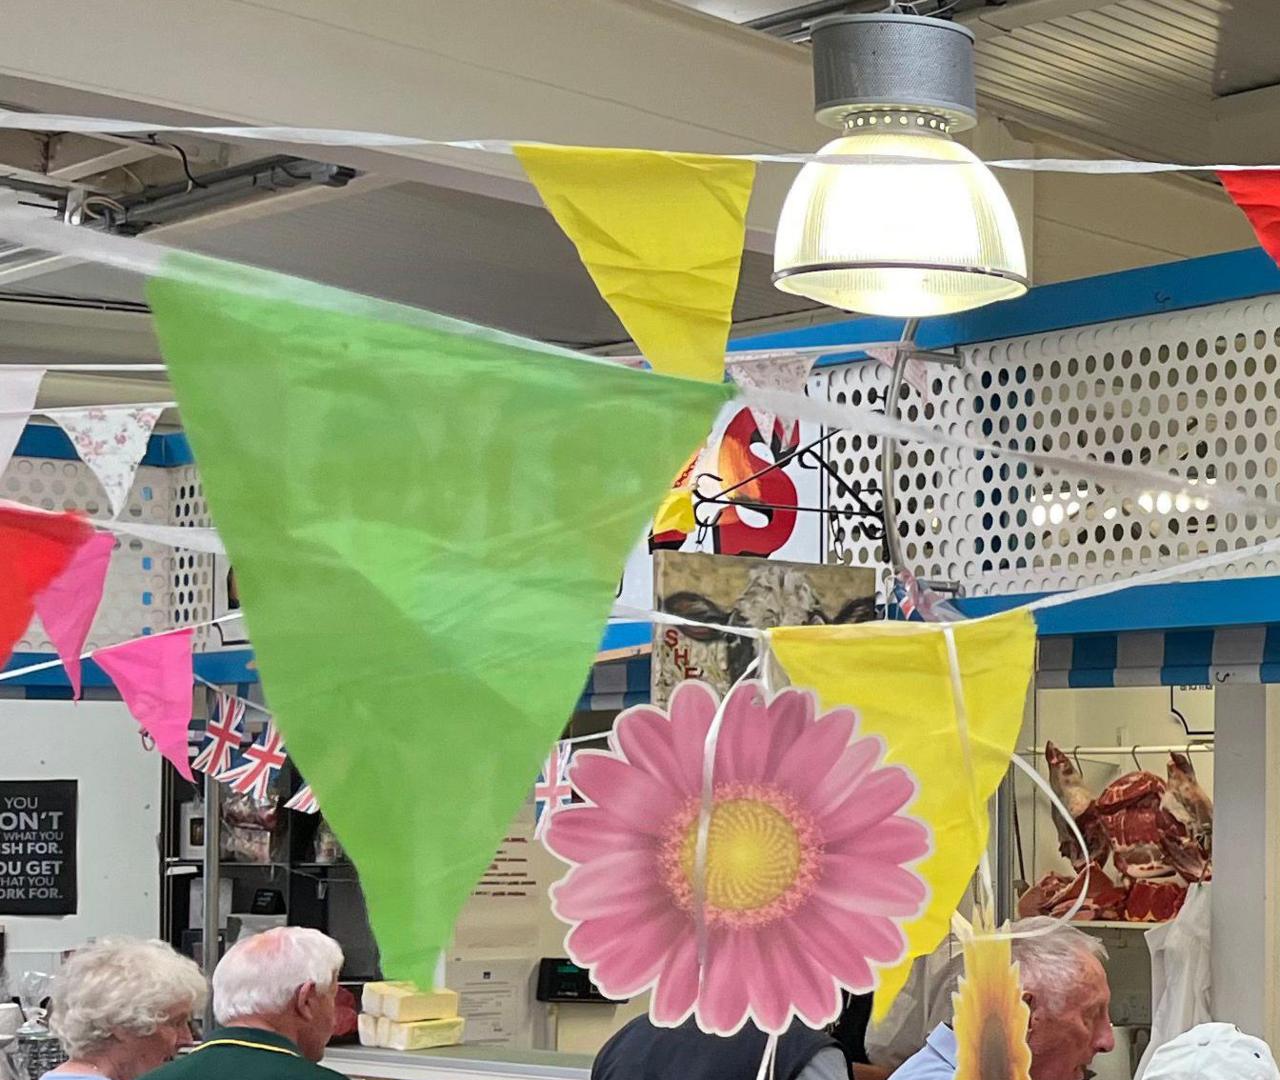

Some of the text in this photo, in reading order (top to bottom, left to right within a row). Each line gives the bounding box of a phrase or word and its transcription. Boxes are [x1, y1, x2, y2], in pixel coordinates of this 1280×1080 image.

[4, 796, 39, 809] YOU
[3, 831, 64, 841] WHAT YOU
[26, 842, 63, 855] FOR.
[25, 860, 64, 875] GET
[27, 876, 55, 887] YOU
[28, 888, 64, 900] FOR.
